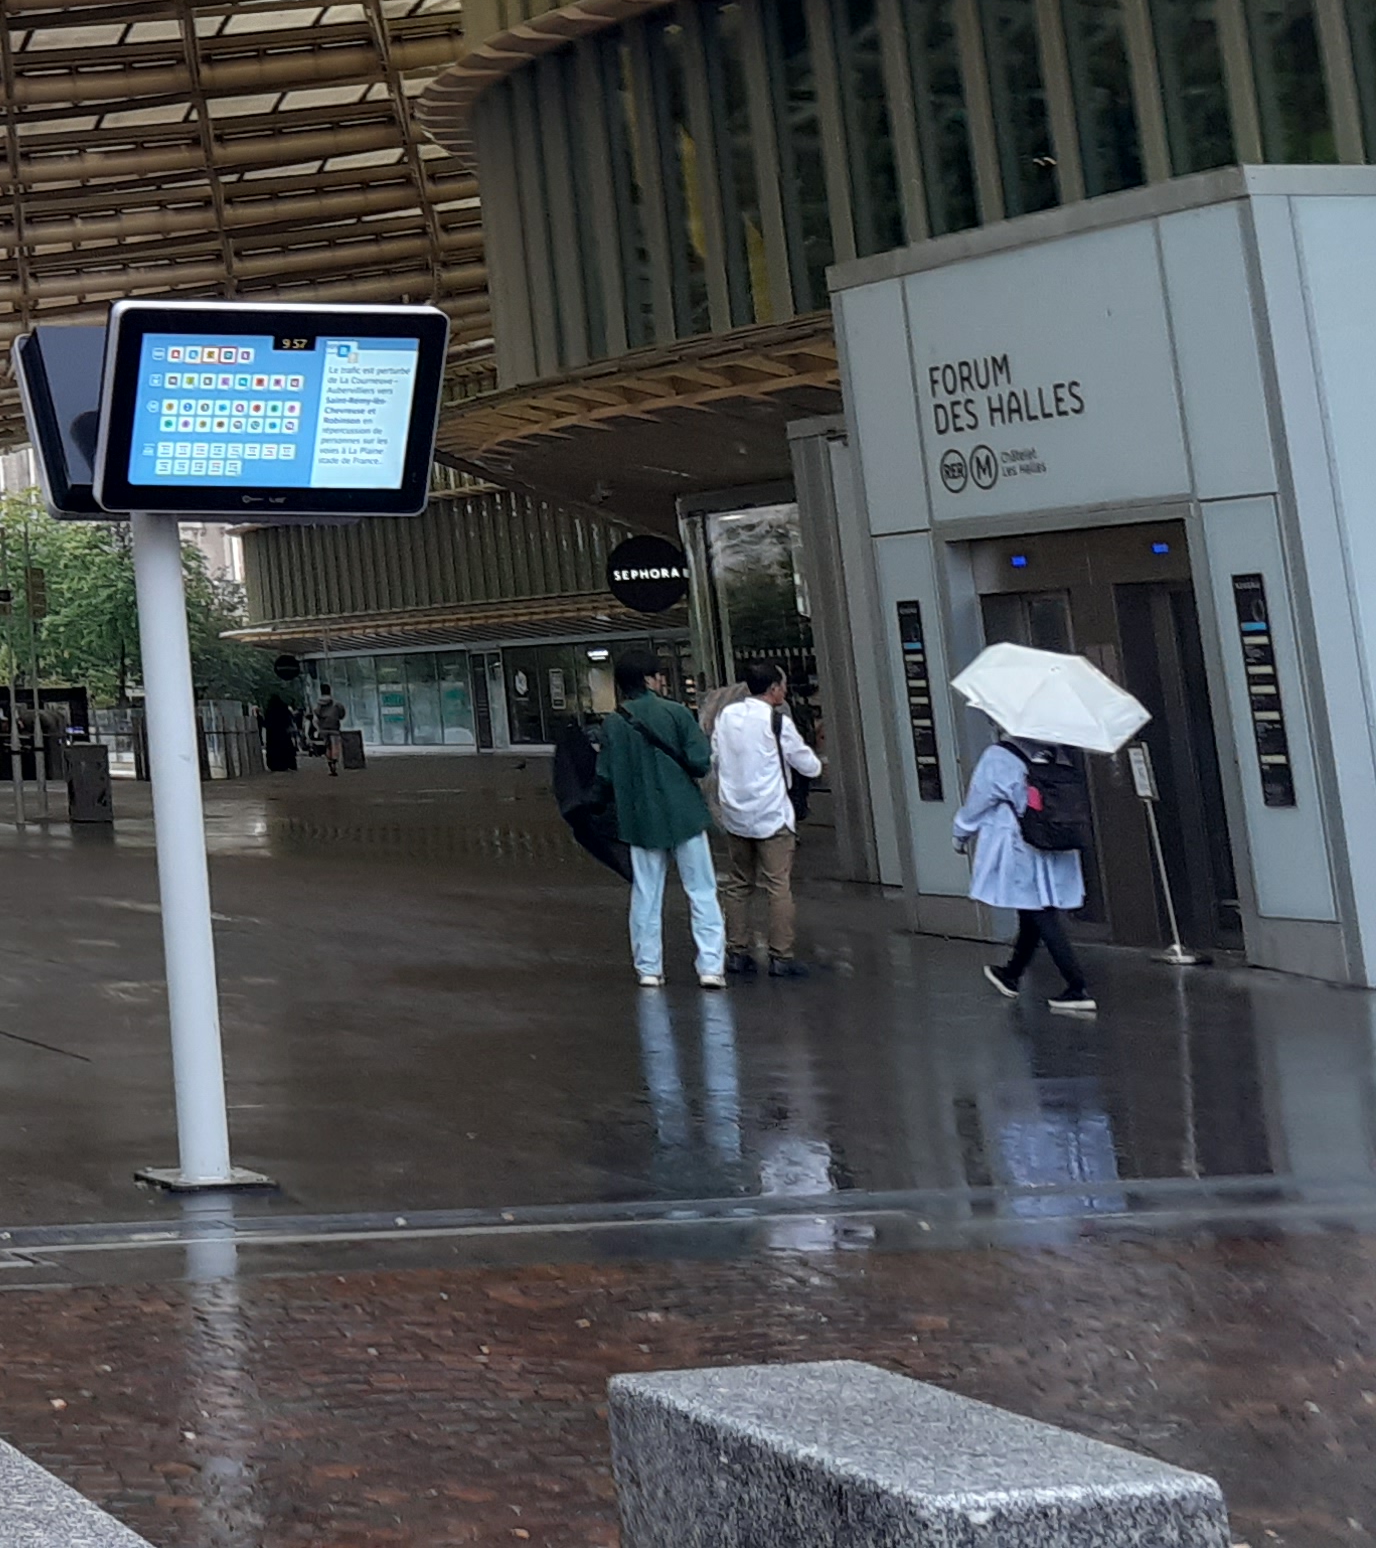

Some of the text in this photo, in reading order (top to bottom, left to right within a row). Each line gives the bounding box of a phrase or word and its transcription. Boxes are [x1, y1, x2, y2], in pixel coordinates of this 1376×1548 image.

[928, 353, 1012, 398] FORUM
[932, 380, 1085, 436] DES HALLES
[943, 462, 966, 480] RER
[612, 566, 681, 582] SEPHORA
